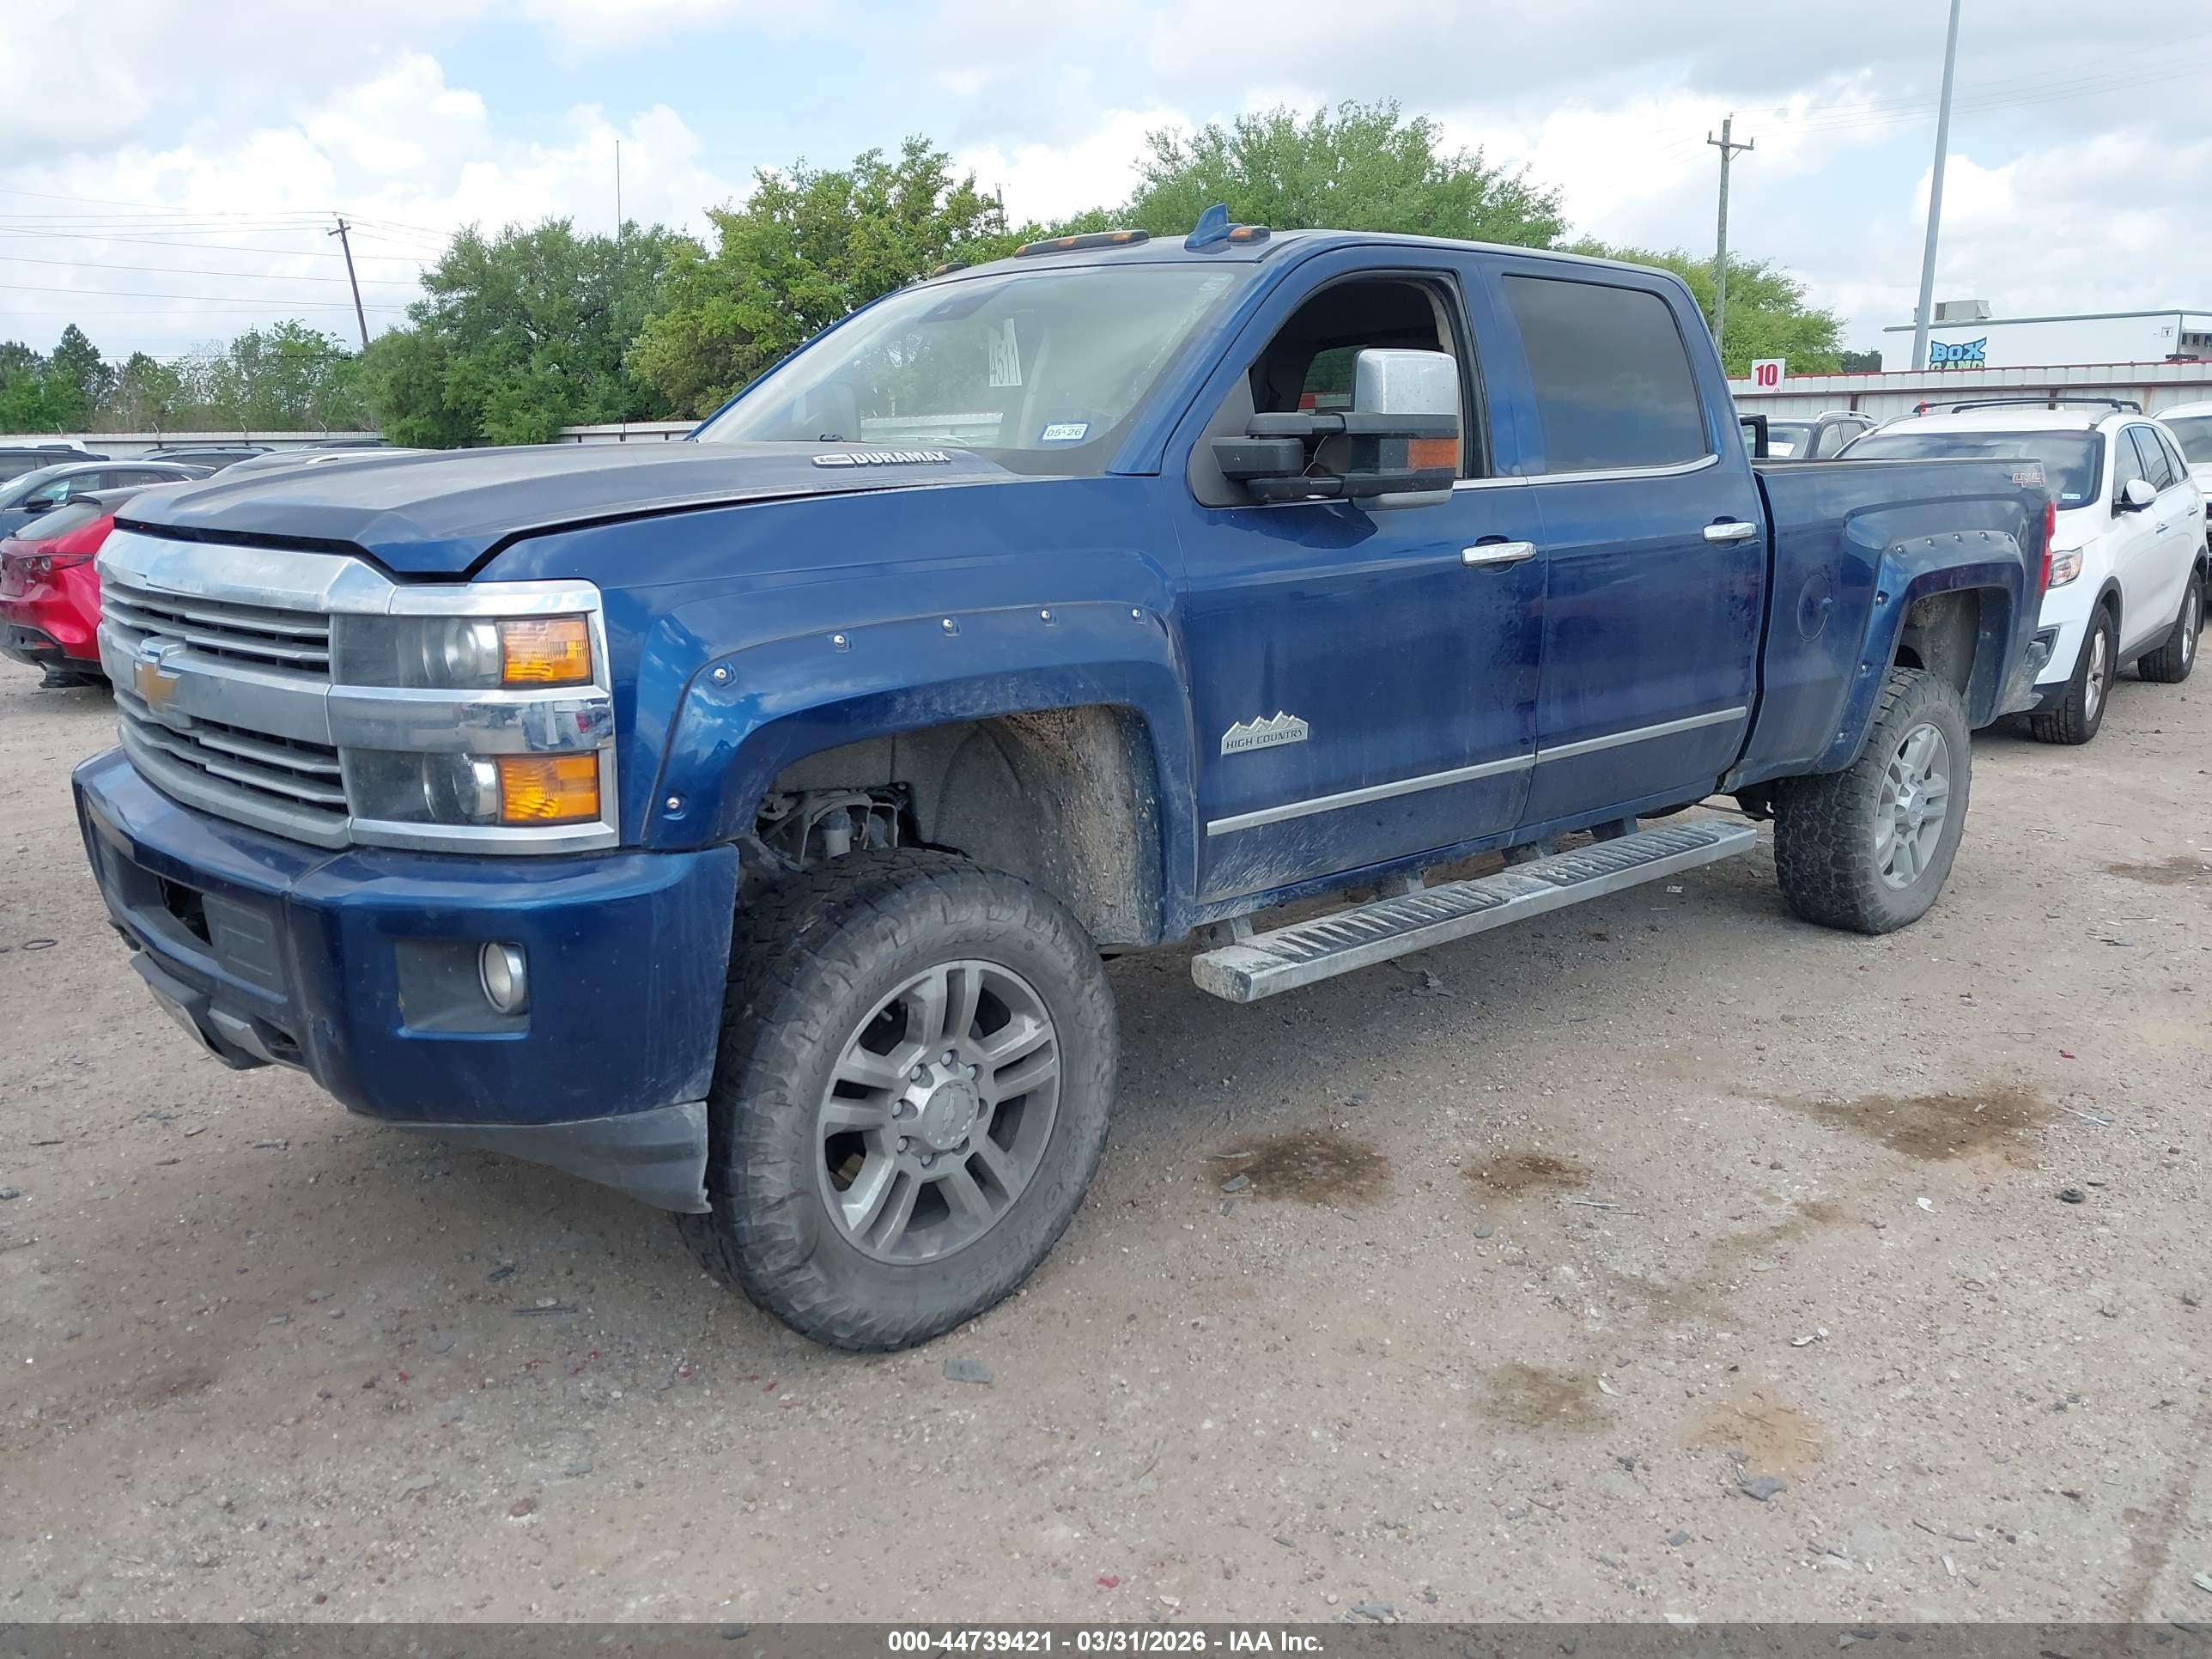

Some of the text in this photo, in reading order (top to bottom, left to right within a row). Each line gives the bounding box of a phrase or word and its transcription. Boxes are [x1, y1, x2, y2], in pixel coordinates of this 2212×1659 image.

[1929, 337, 1987, 362] BOX
[1755, 364, 1778, 386] 10
[851, 451, 952, 465] DURAMAX
[1226, 728, 1304, 750] HIGH COUNTRY
